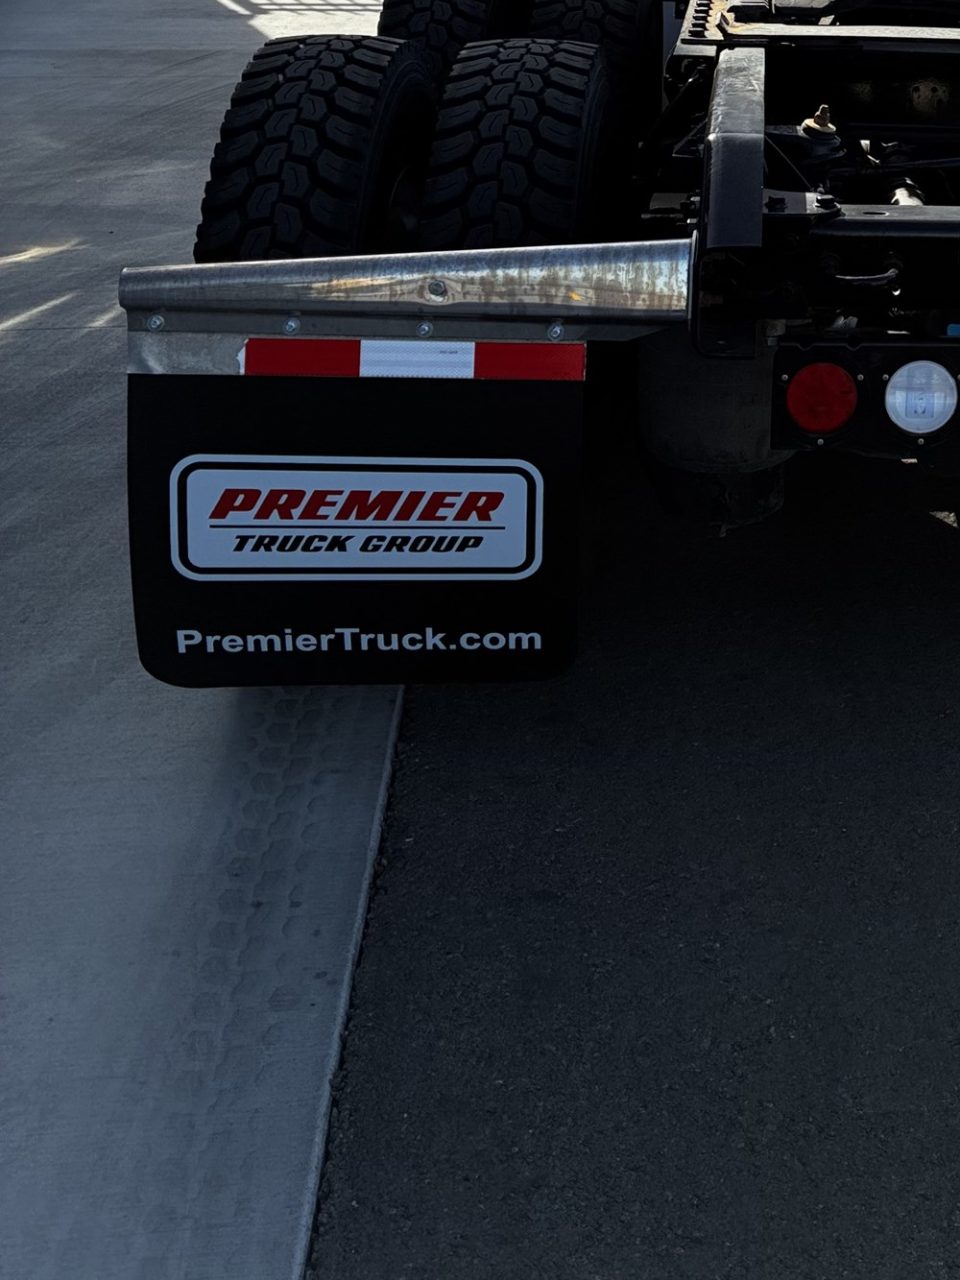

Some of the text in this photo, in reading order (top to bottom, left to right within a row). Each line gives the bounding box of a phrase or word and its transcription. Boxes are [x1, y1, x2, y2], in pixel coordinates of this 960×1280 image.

[208, 488, 505, 522] PREMIER
[232, 534, 484, 554] TRUCK GROUP
[176, 628, 542, 654] PremierTruck.com
